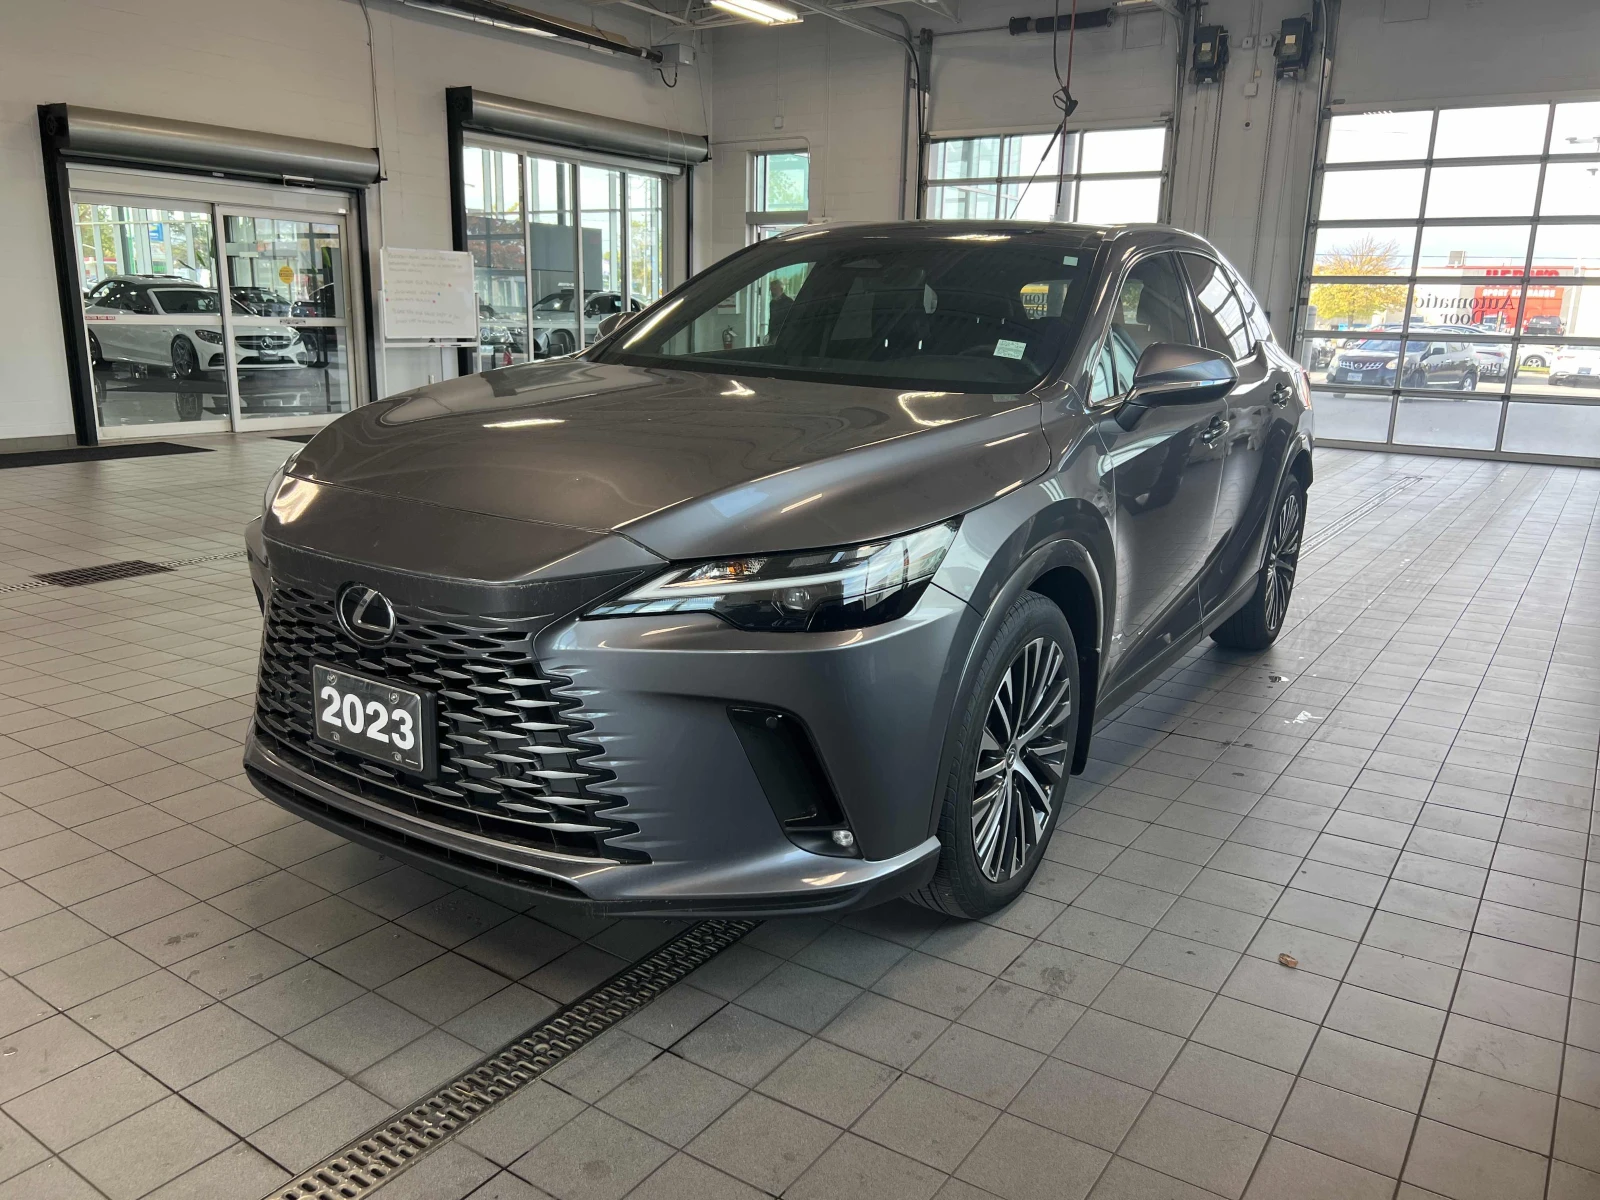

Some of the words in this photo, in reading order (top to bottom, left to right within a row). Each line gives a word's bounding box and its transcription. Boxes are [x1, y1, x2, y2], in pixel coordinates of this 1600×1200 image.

[1482, 288, 1509, 297] SPORT
[1511, 288, 1556, 298] EXHANGE
[320, 685, 415, 750] 2023
